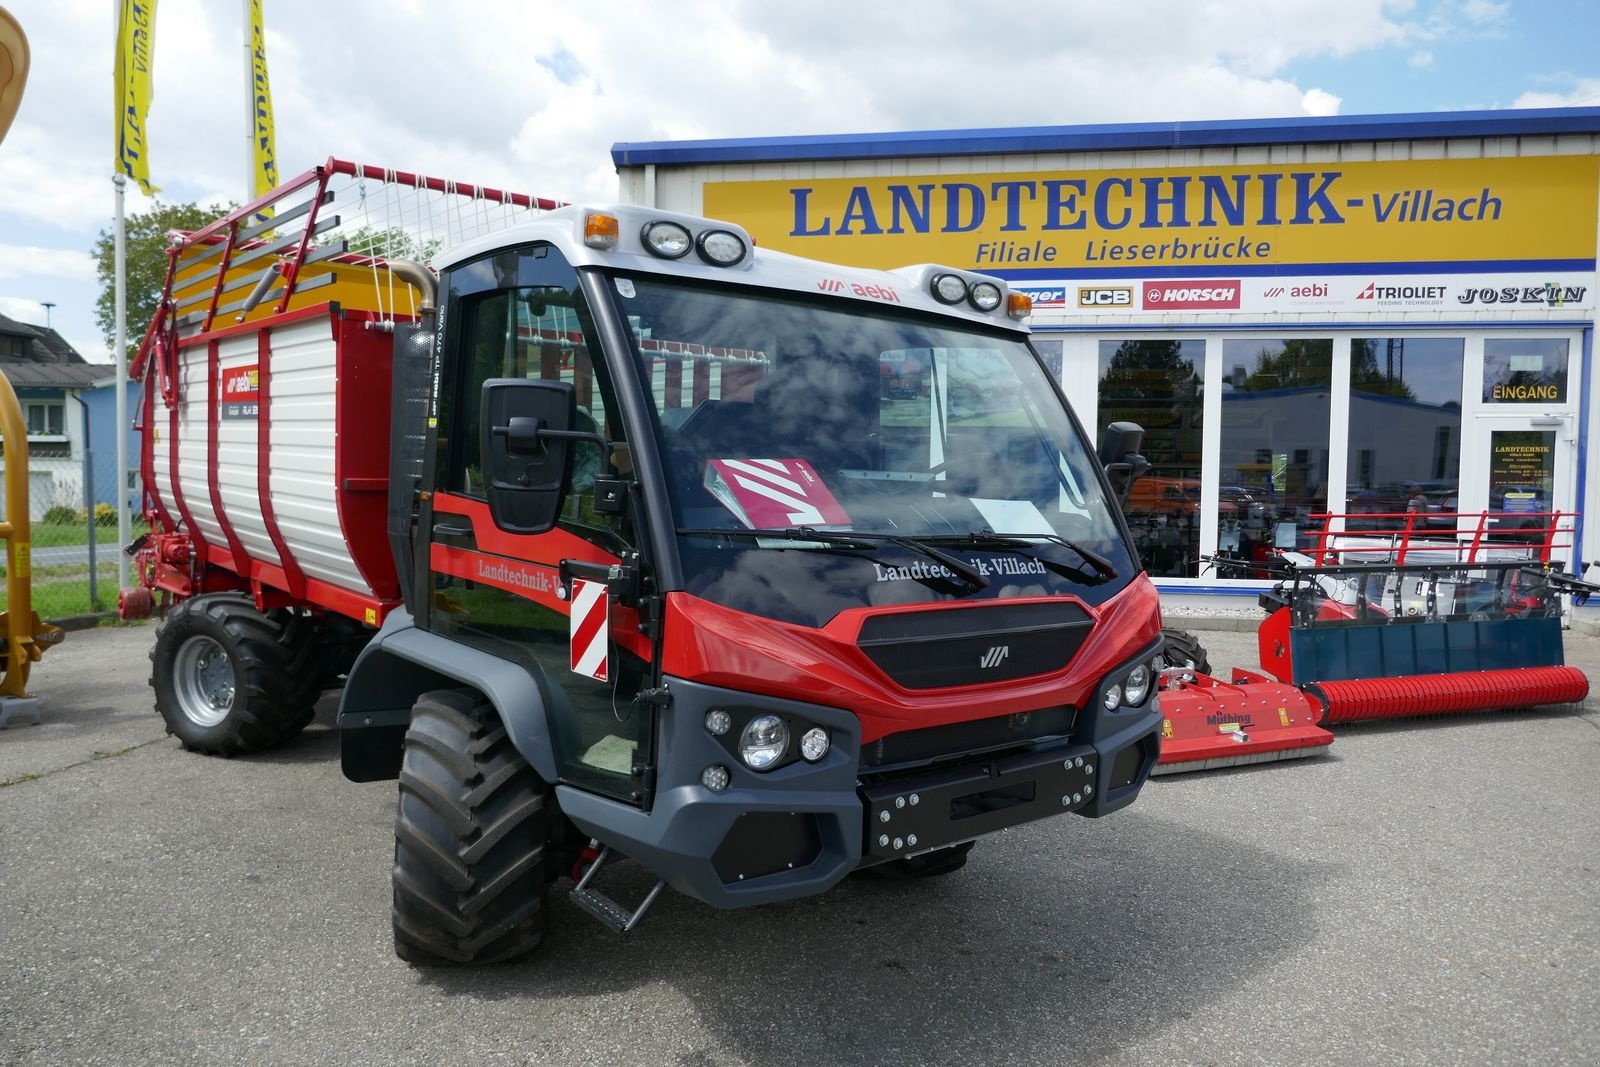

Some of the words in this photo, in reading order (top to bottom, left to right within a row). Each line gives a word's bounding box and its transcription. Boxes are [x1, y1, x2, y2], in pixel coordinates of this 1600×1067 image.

[975, 240, 1058, 263] Filiale
[1085, 236, 1271, 262] Lieserbrücke
[850, 283, 901, 303] aebi
[1081, 289, 1130, 305] JCB
[1162, 288, 1236, 302] HORSCH
[1290, 284, 1328, 298] aebi
[1375, 286, 1447, 299] TRIOLIET
[1457, 287, 1587, 304] JOSKIN
[1493, 385, 1558, 399] EINGANG
[1206, 710, 1251, 726] Müthing
